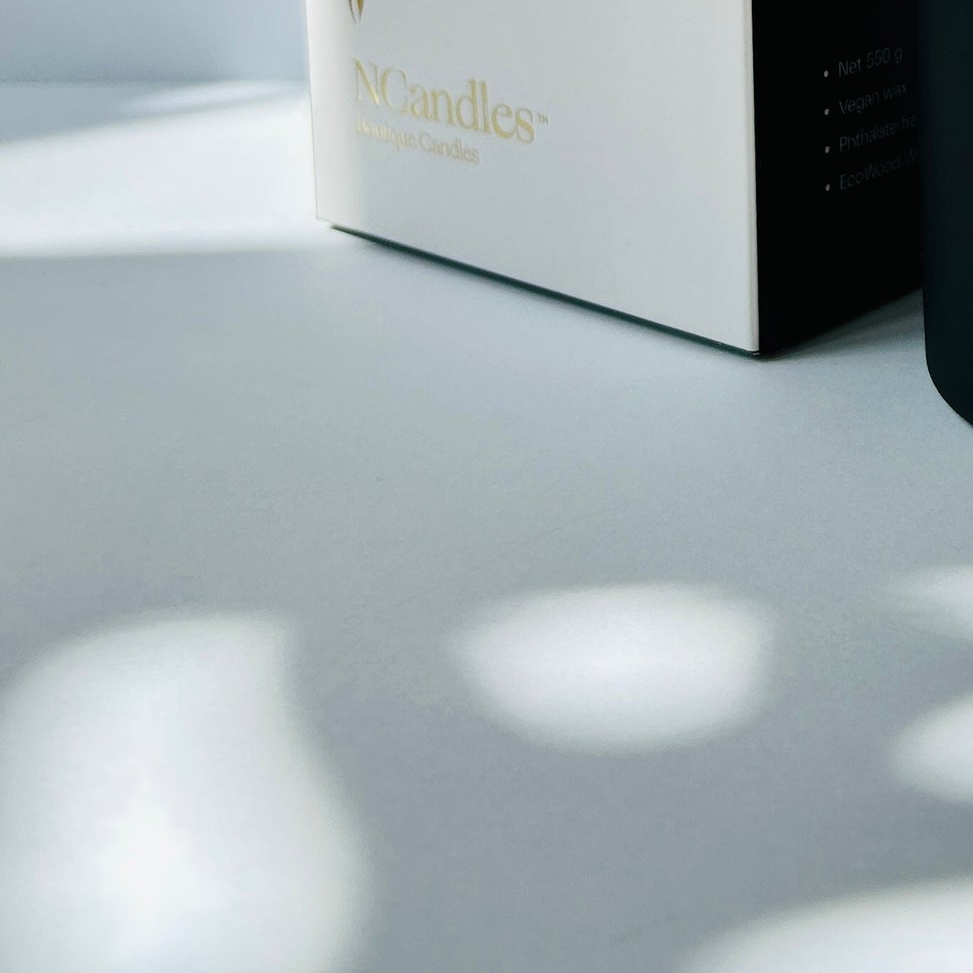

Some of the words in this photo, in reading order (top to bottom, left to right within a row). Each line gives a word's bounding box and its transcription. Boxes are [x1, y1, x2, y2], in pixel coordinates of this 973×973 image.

[838, 55, 862, 77] Net
[865, 47, 890, 69] 550
[894, 47, 904, 64] g
[838, 91, 881, 115] Vegan
[418, 131, 480, 164] Candles
[839, 122, 897, 153] Phthalate
